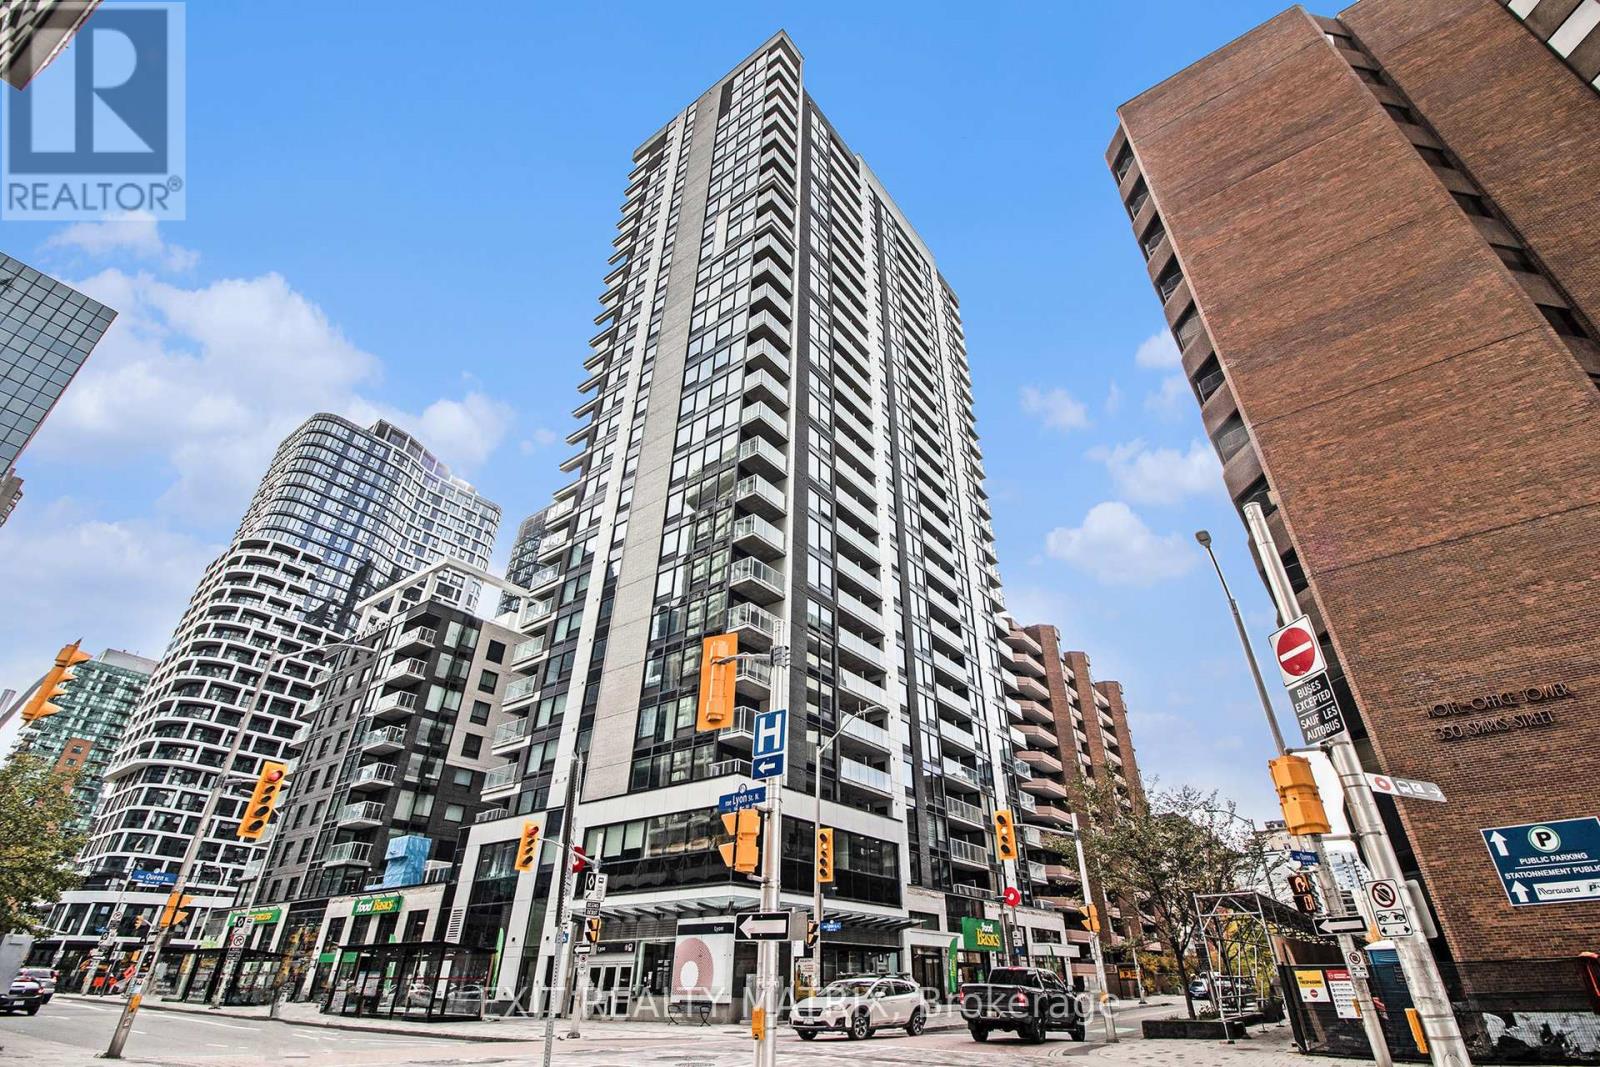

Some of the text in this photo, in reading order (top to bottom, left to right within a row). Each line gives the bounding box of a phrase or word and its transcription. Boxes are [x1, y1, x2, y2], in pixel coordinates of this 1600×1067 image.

[1296, 680, 1321, 698] BUSES
[1471, 693, 1515, 710] OFFICE
[1519, 681, 1570, 702] TOWER
[1295, 689, 1331, 713] EXCEPTED
[1300, 705, 1338, 729] SAUF LES
[1435, 710, 1554, 740] 350 SPARKS STREET
[757, 713, 782, 753] H
[1306, 718, 1341, 741] AUTOBUS
[732, 794, 748, 807] Lyon
[1535, 831, 1552, 847] P
[1519, 851, 1589, 865] PUBLIC PARKING
[145, 873, 164, 881] Queen
[1504, 867, 1571, 880] STATIONNEMENT
[356, 900, 374, 912] food
[981, 922, 994, 933] food
